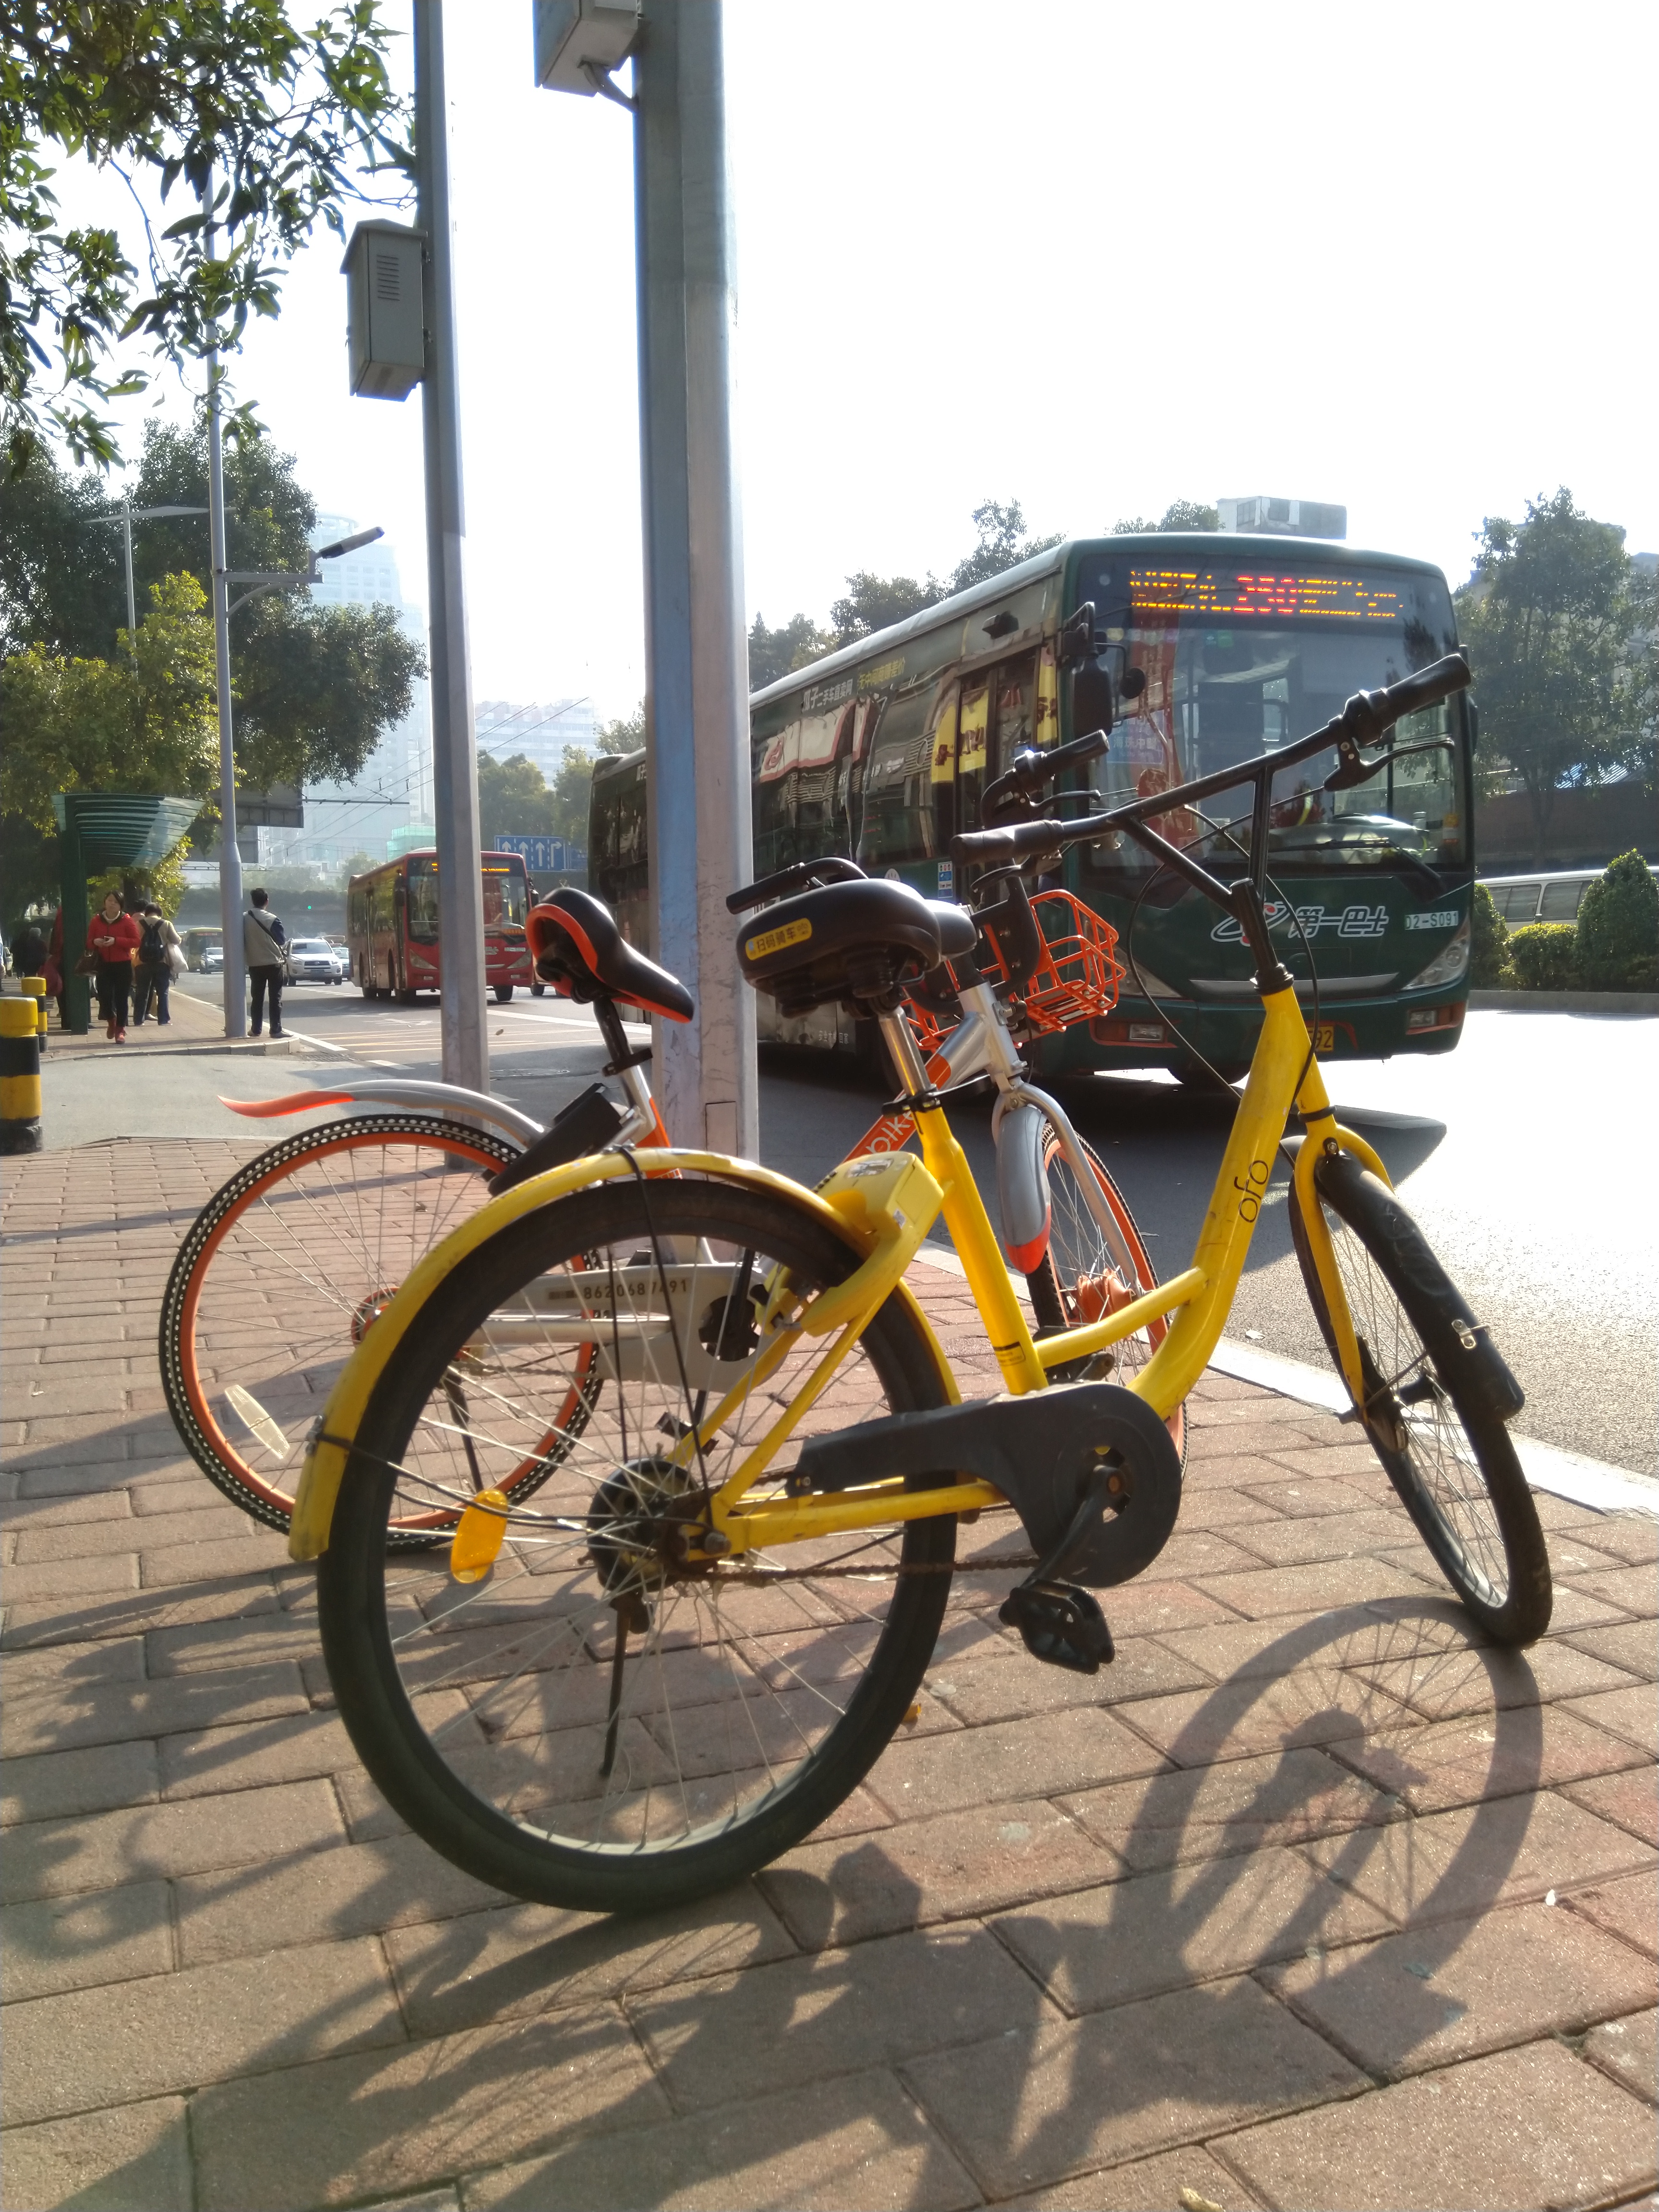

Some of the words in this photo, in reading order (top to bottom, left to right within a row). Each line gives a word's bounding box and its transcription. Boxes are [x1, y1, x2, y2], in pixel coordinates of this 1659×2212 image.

[1287, 905, 1389, 938] 第一巴士
[1307, 1030, 1333, 1048] 92
[1234, 1160, 1269, 1223] ofo
